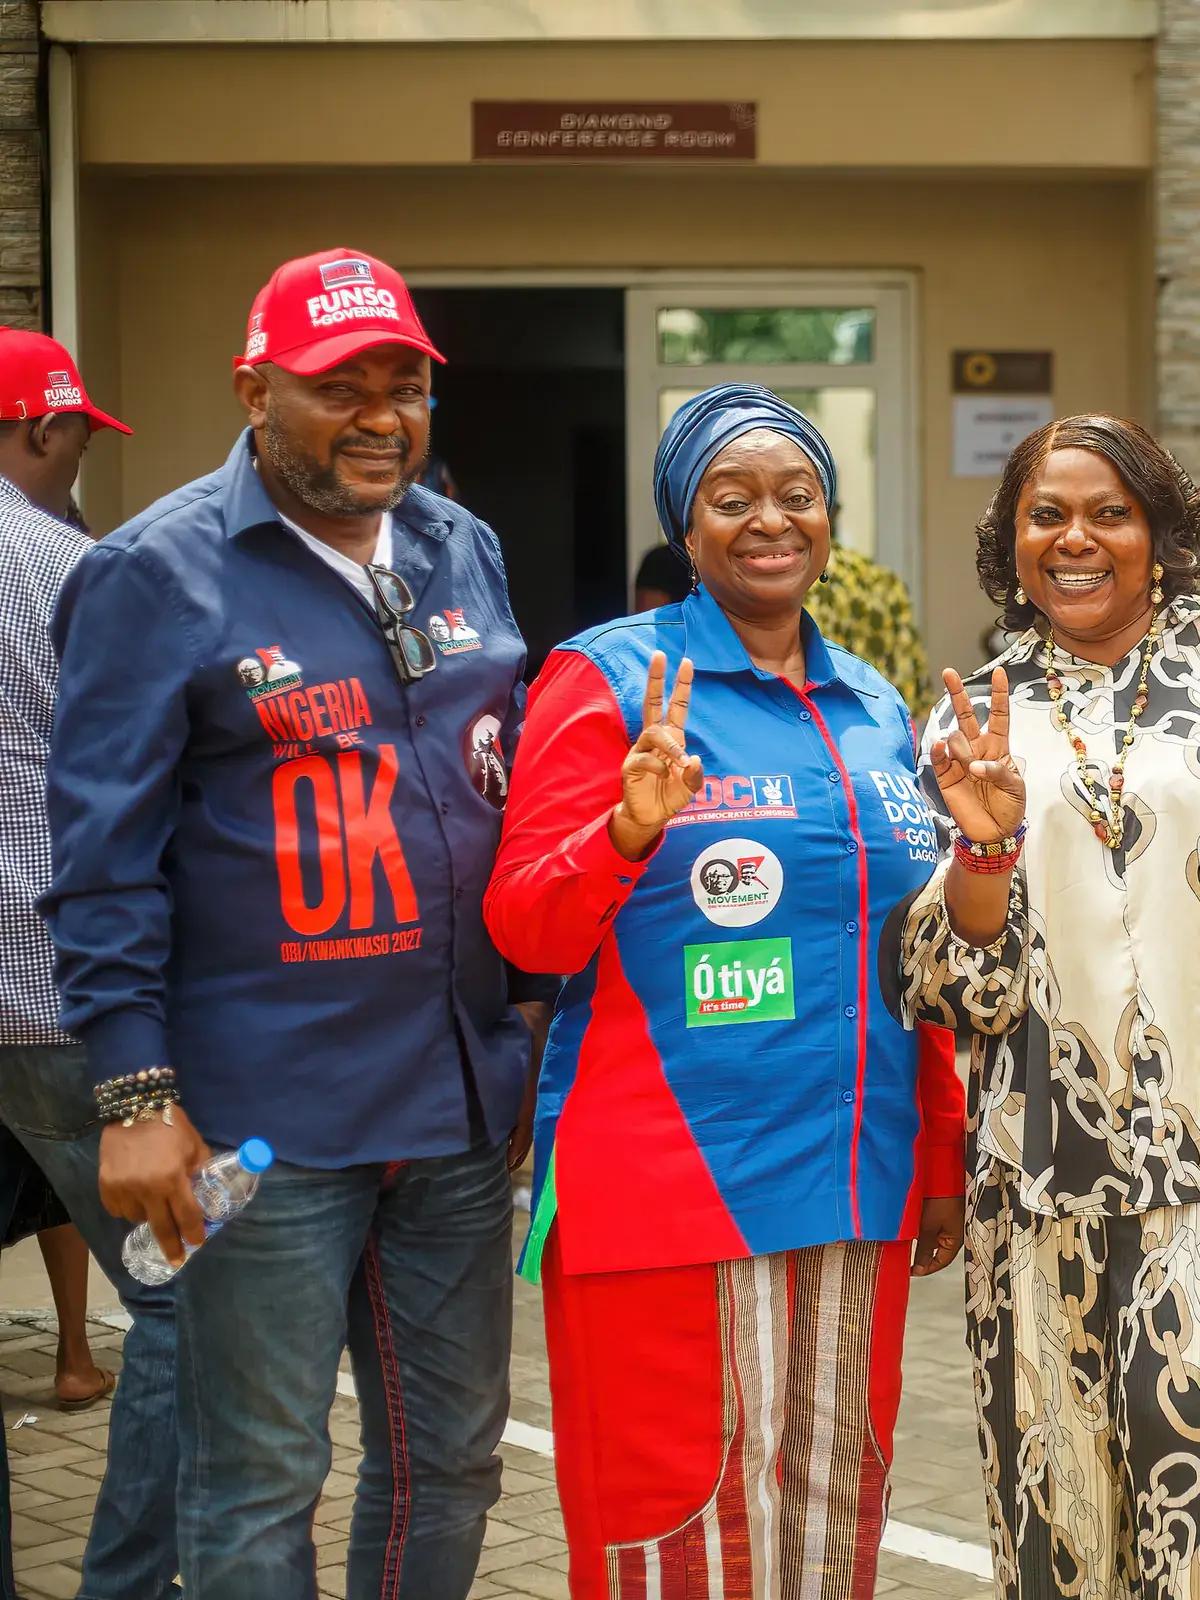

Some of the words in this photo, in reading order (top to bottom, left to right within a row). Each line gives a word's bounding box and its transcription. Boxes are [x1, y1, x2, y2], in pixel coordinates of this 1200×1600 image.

[560, 113, 672, 130] DIAMOND
[497, 130, 657, 148] CONFERENCE
[664, 131, 736, 148] ROOM
[306, 286, 396, 318] FUNSO
[320, 305, 400, 326] GOVERNOR
[44, 387, 81, 401] FUNSO
[246, 670, 303, 699] MOVEMENT
[255, 677, 373, 742] NIGERIA
[272, 743, 319, 759] WILL
[335, 731, 364, 750] BE
[680, 776, 753, 812] DC
[697, 810, 753, 821] DEMOCRATIC
[754, 809, 795, 817] CONGRESS
[271, 743, 420, 936] OK
[707, 892, 769, 904] MOVEMENT
[281, 933, 389, 963] OBI/KWANKWASO
[392, 928, 423, 952] 2027
[702, 1002, 719, 1012] it's
[721, 1002, 745, 1011] time
